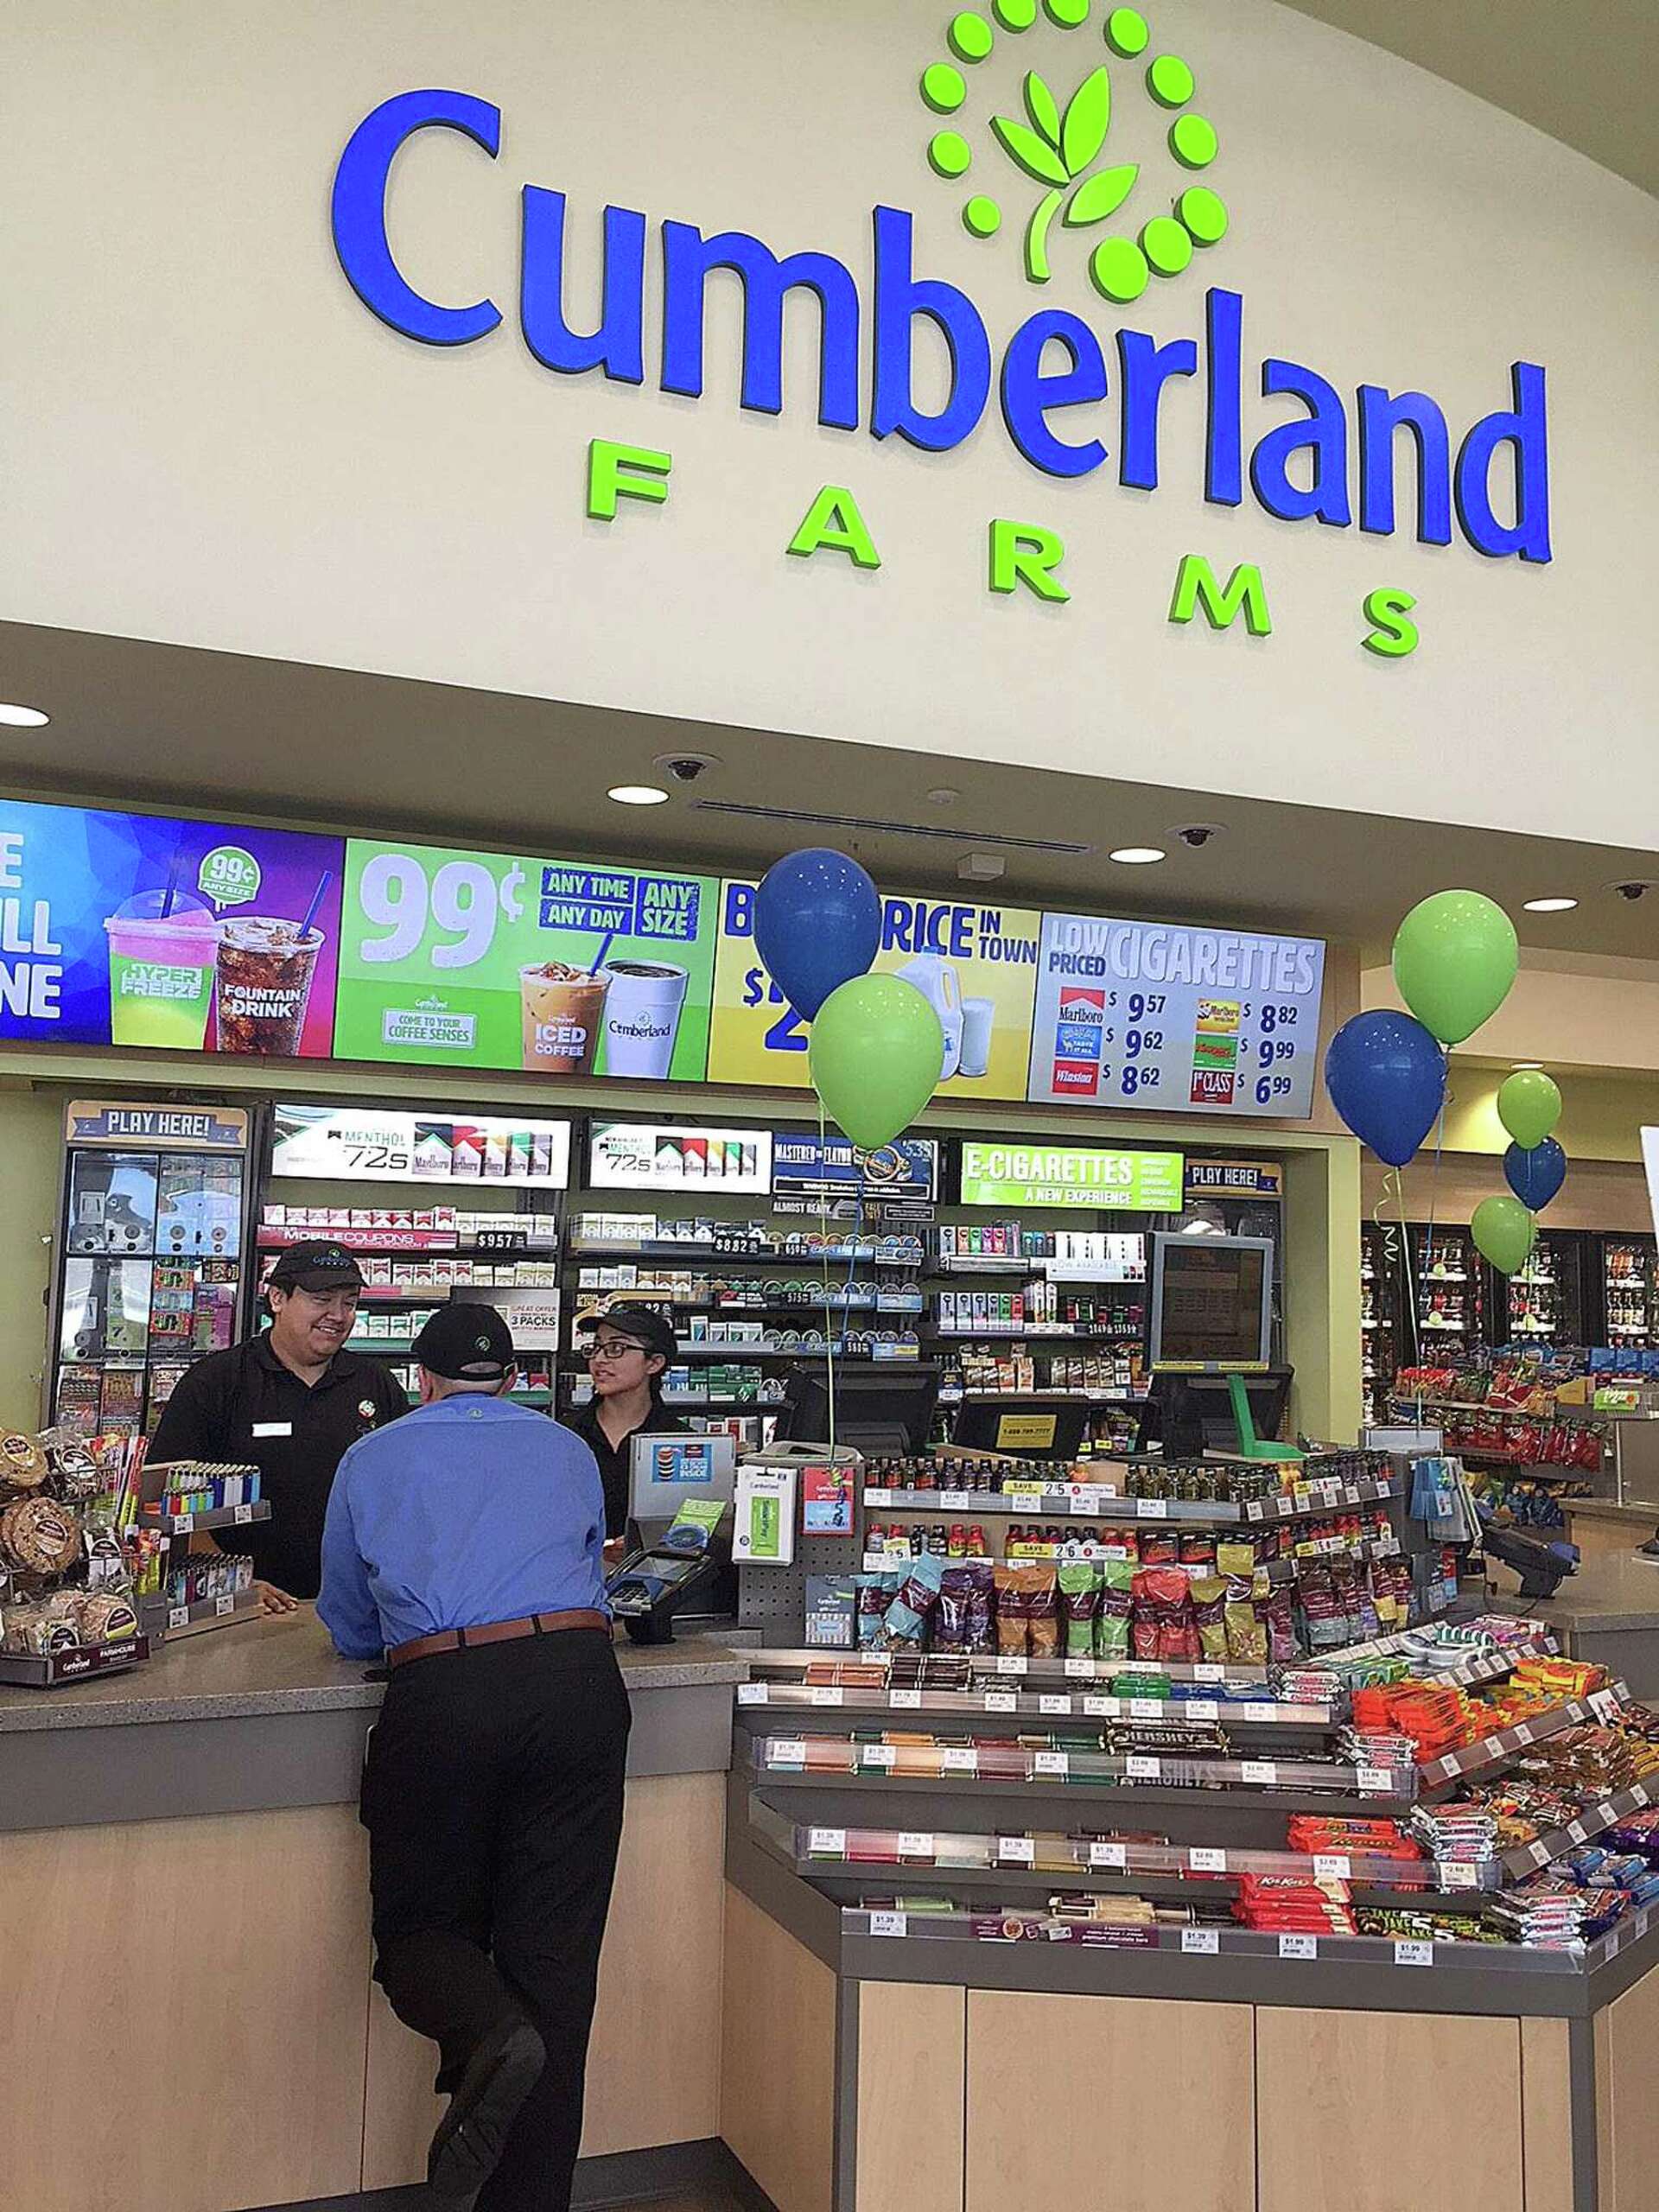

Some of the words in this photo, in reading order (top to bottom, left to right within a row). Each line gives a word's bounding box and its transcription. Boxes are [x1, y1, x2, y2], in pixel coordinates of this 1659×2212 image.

[332, 89, 1552, 564] Cumberland
[587, 438, 1420, 658] FARMS
[547, 872, 586, 894] ANY
[590, 876, 630, 899] TIME
[643, 882, 692, 909] ANY
[359, 854, 526, 969] 99¢
[547, 904, 586, 925] ANY
[589, 909, 626, 930] DAY
[642, 908, 689, 935] SIZE
[881, 899, 976, 958] RICE
[979, 910, 1001, 934] IN
[1051, 920, 1109, 955] LOW
[978, 936, 1037, 963] TOWN
[1048, 952, 1107, 977] PRICED
[1109, 926, 1318, 995] CIGARETTES
[129, 964, 197, 983] HYPER
[121, 979, 201, 1000] FREEZE
[223, 983, 302, 1002] FOUNTAIN
[231, 998, 294, 1018] DRINK
[1058, 1006, 1104, 1024] Marlboro
[424, 1017, 435, 1027] TO
[388, 1025, 427, 1039] COFFEE
[429, 1027, 470, 1042] SENSES
[535, 1024, 588, 1044] ICED
[535, 1043, 586, 1058] COFFEE
[1056, 1069, 1093, 1084] Winston
[1204, 1072, 1233, 1093] CLASS
[107, 1110, 155, 1134] PLAY
[158, 1115, 210, 1137] HERE!
[345, 1131, 406, 1147] MENTHOL
[342, 1144, 409, 1169] 72s
[774, 1144, 816, 1160] MASTERED
[606, 1154, 652, 1173] 72s
[967, 1147, 1134, 1186] E-CIGARETTES
[1192, 1166, 1222, 1184] PLAY
[1224, 1169, 1258, 1186] HERE!
[1025, 1187, 1035, 1202] A
[1037, 1188, 1064, 1203] NEW
[1065, 1189, 1134, 1205] EXPERIENCE
[773, 1202, 804, 1213] ALMOST
[512, 1315, 518, 1325] 3
[520, 1315, 556, 1326] PACKS
[1124, 1730, 1211, 1744] HERSHEY'S
[1285, 1937, 1305, 1946] $1.99
[1401, 1944, 1421, 1953] $1.99
